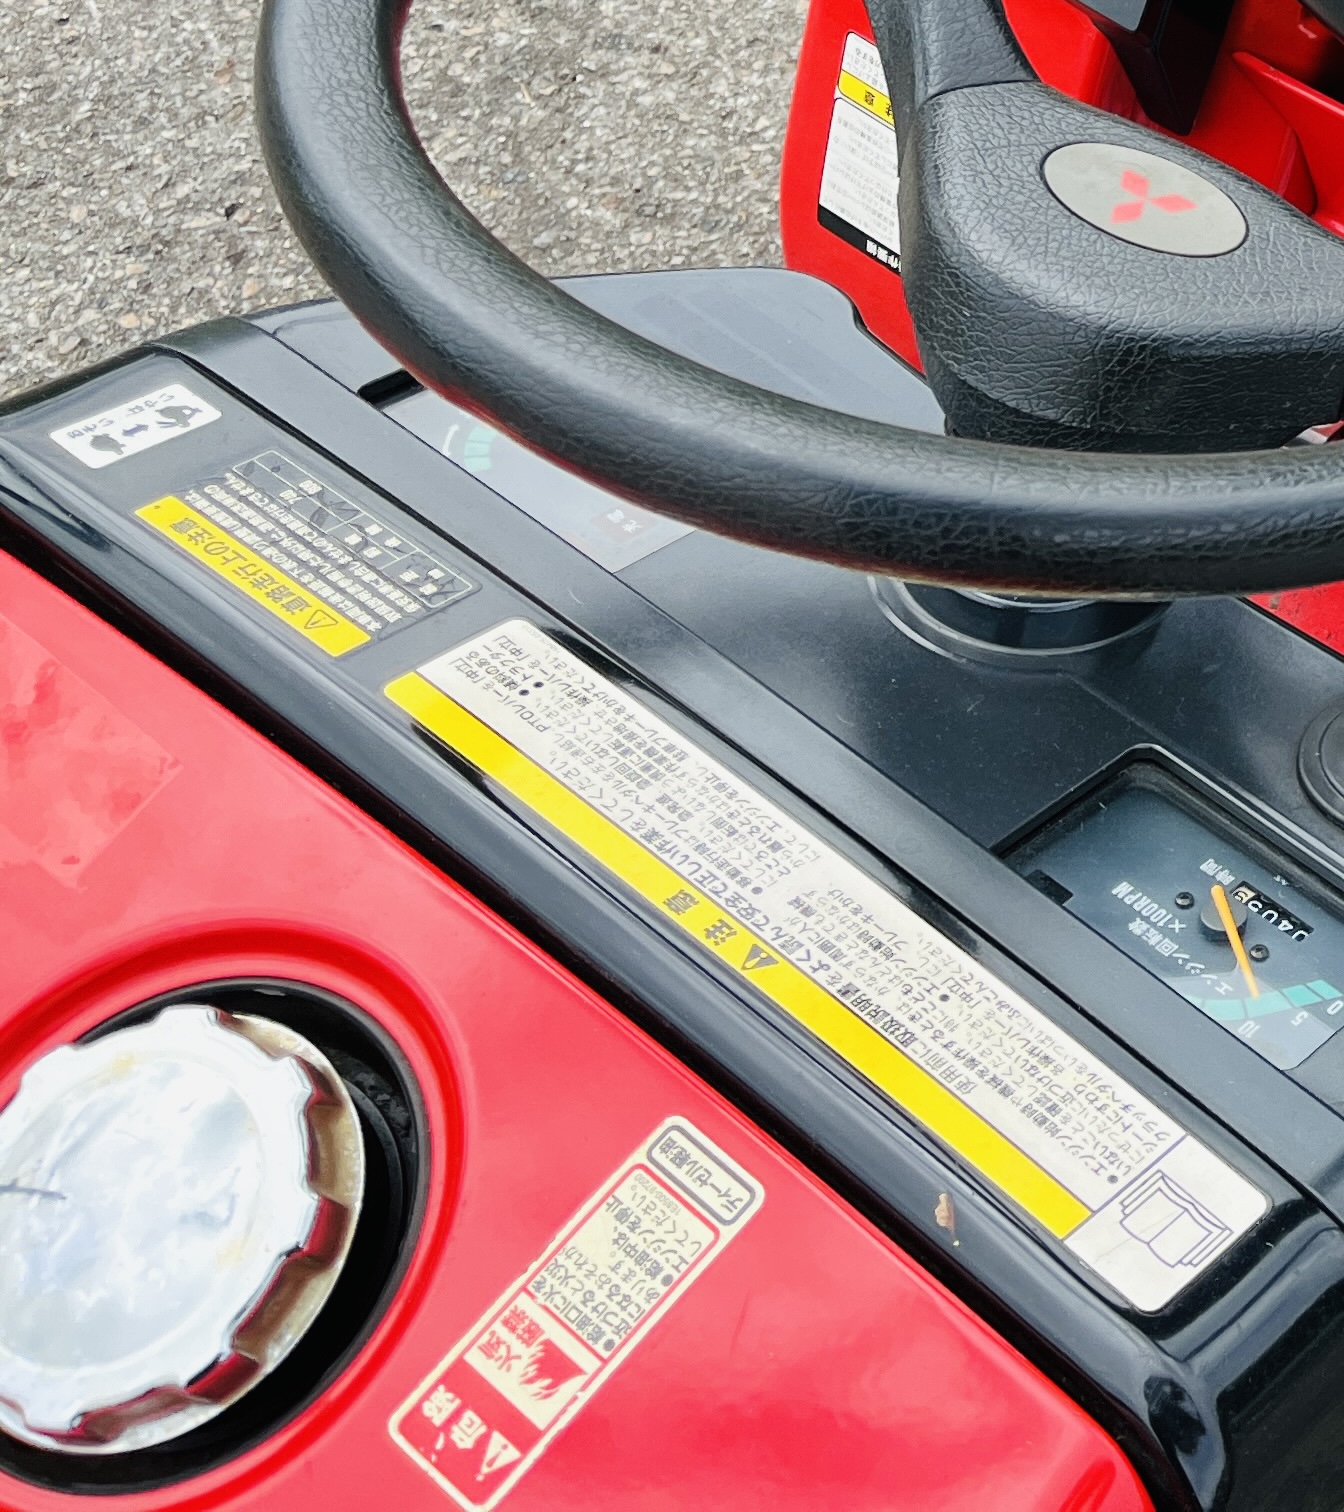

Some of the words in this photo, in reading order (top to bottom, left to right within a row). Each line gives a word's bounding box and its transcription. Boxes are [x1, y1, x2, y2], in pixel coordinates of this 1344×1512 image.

[167, 515, 313, 616] 道路走行上の注意
[1199, 857, 1237, 887] 時間
[538, 748, 981, 1097] 使用前に取扱説明書をよく読んで安全で正しい作業をしてください。
[659, 886, 741, 948] 注意
[1127, 916, 1234, 996] エンジン回転数
[1236, 1019, 1262, 1039] 10
[1289, 1009, 1310, 1027] 5
[655, 1134, 745, 1215] ディーゼル軽油
[601, 1193, 690, 1274] エンジンを停止
[603, 1224, 665, 1281] 給油中は、
[622, 1183, 704, 1257] してください。
[528, 1274, 608, 1346] 給油口に火を
[542, 1257, 633, 1340] 近づけると火災
[557, 1241, 646, 1323] になるおそれが
[600, 1249, 661, 1306] あります。
[471, 1328, 526, 1375] 火気
[493, 1302, 550, 1351] 厳禁
[409, 1382, 496, 1455] 危険
